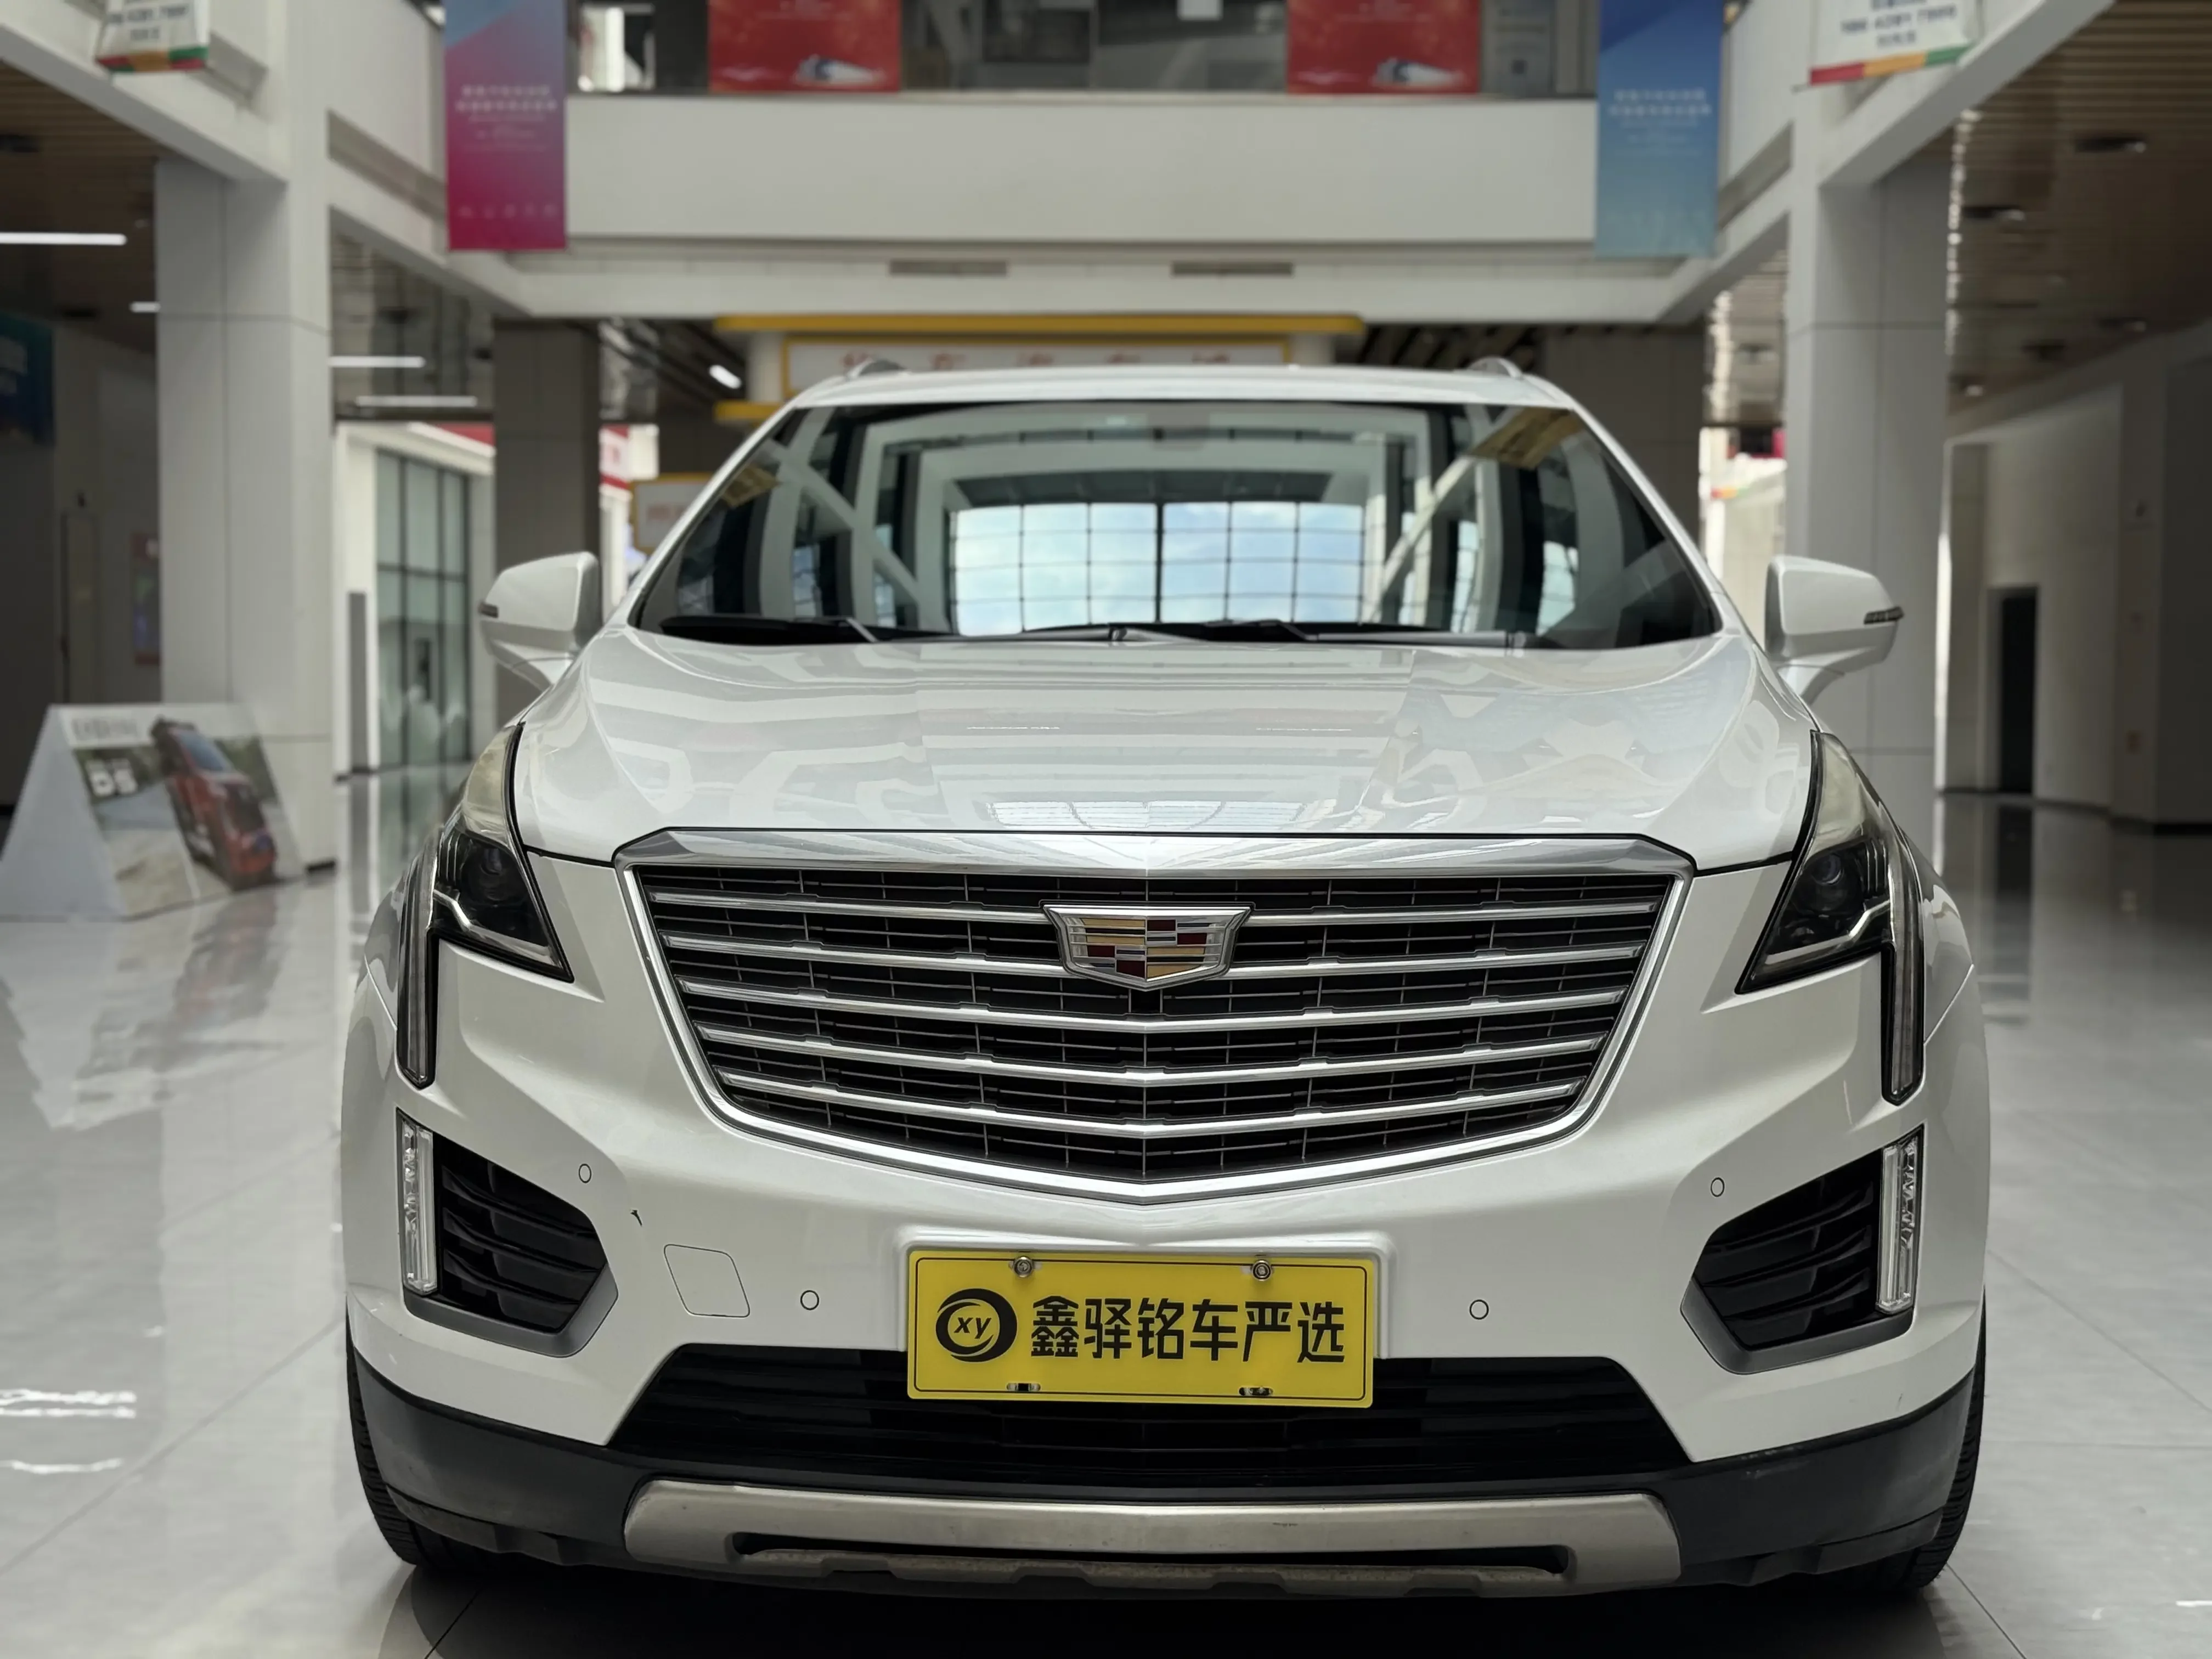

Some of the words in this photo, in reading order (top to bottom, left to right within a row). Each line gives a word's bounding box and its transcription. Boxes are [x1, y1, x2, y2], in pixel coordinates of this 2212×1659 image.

[1031, 1295, 1345, 1363] 鑫驿铭车严选
